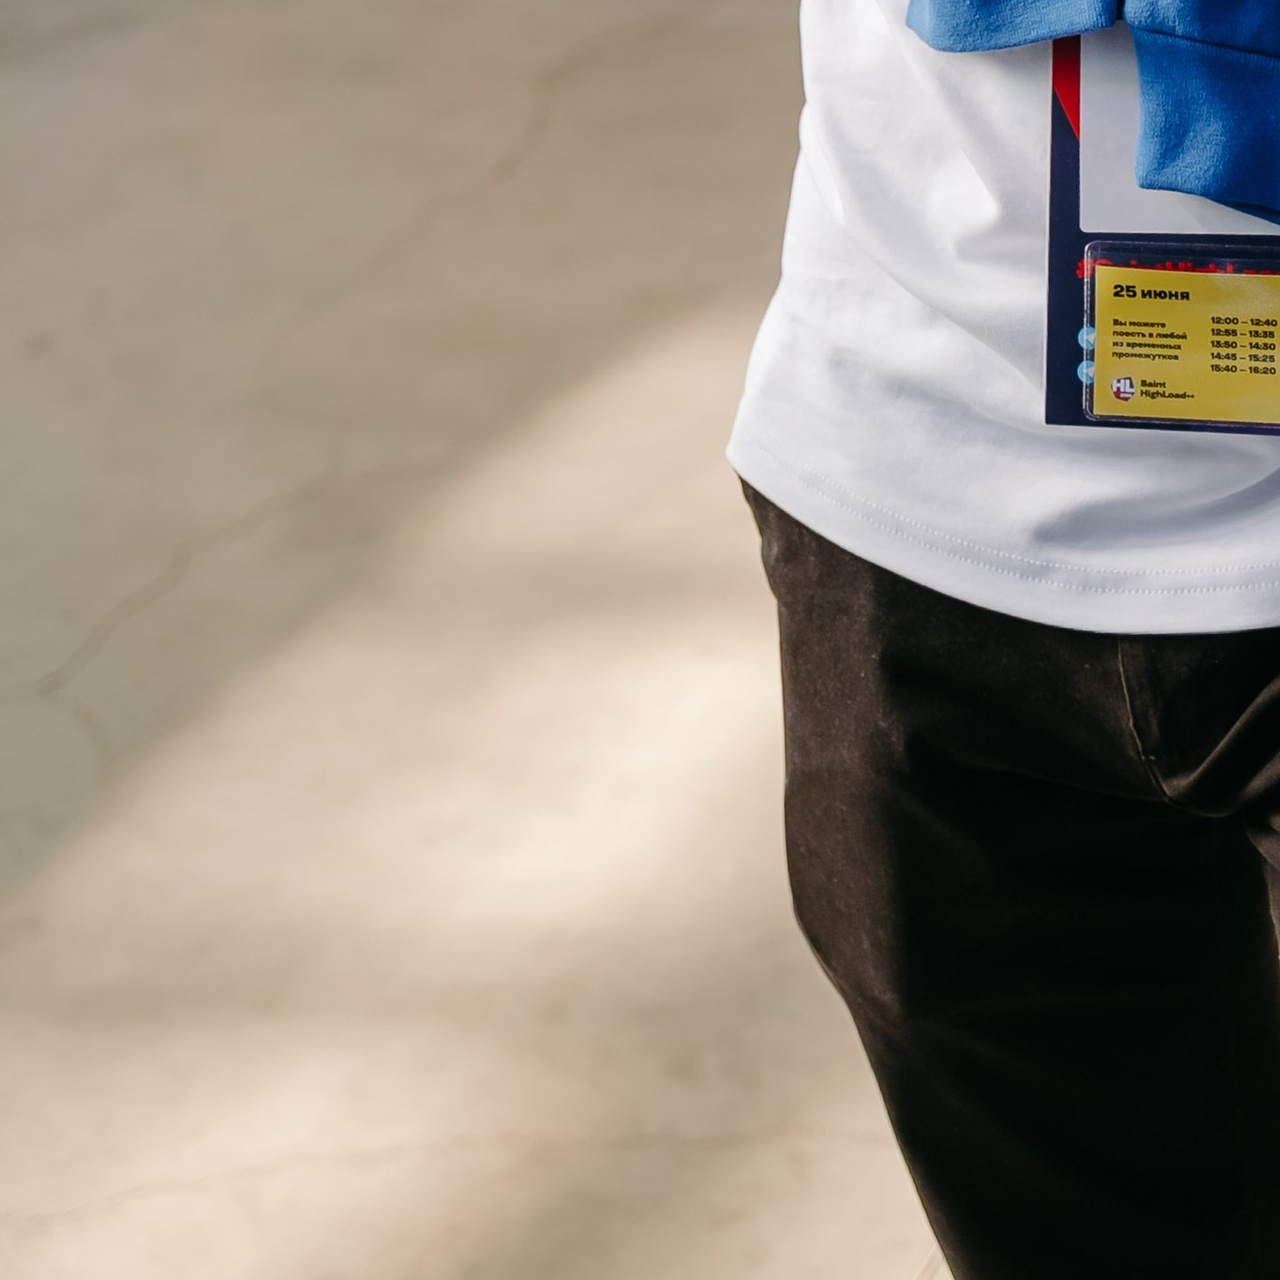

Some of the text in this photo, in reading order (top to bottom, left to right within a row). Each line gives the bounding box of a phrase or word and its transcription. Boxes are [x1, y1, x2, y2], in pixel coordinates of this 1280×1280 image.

[1113, 284, 1190, 301] 25 июня
[1113, 318, 1127, 326] Вы
[1210, 316, 1239, 325] 12:00
[1250, 318, 1278, 327] 12:40
[1112, 330, 1146, 338] поесть
[1155, 331, 1188, 340] любой
[1210, 328, 1238, 337] 12:55
[1248, 330, 1275, 339] 13:35
[1126, 342, 1182, 350] временных
[1210, 340, 1238, 349] 13:50
[1248, 342, 1276, 351] 14:30
[1111, 352, 1179, 361] промежутков
[1210, 352, 1238, 361] 14:45
[1248, 354, 1275, 363] 15:25
[1210, 364, 1238, 373] 15:40
[1248, 366, 1277, 375] 16:20
[1112, 379, 1135, 393] HL
[1140, 380, 1167, 389] Saint
[1140, 389, 1195, 400] HighLoad++
